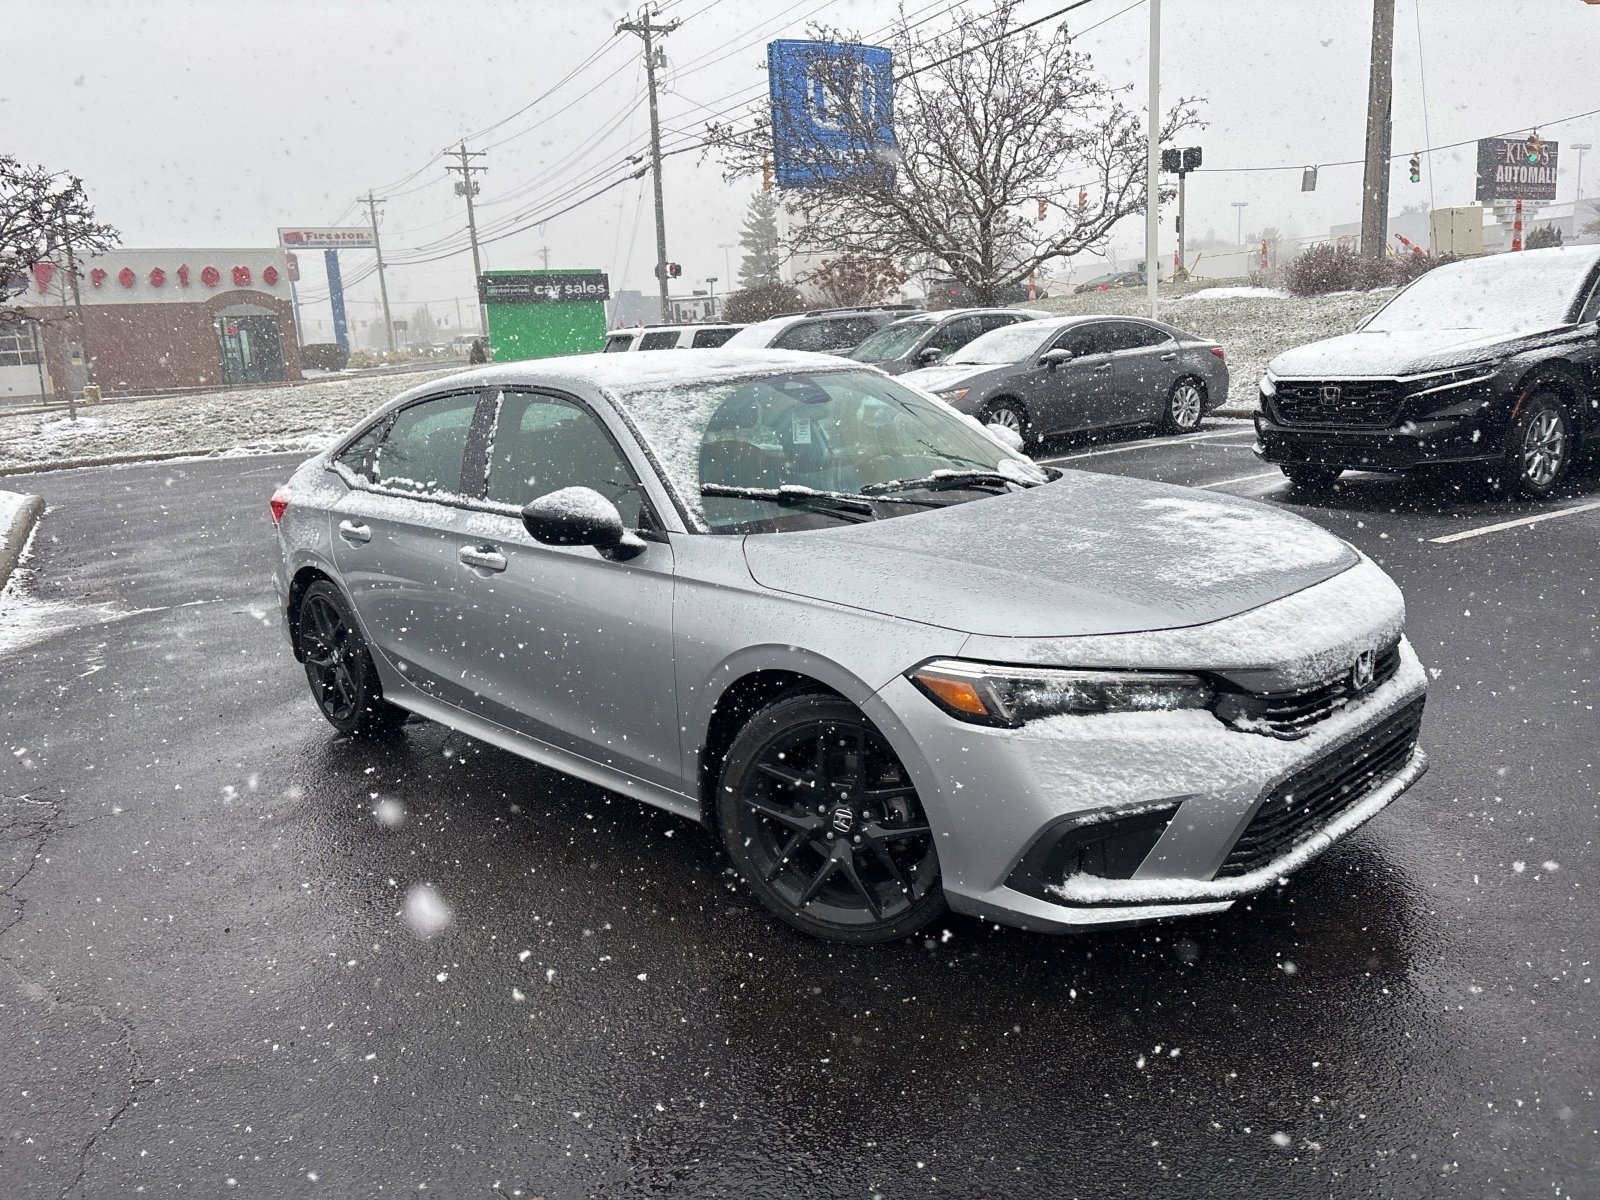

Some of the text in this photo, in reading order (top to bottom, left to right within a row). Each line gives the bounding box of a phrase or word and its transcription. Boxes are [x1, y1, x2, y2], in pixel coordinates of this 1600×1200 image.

[1505, 142, 1549, 165] KINS
[1496, 165, 1557, 184] AUTOMALL
[534, 284, 562, 295] car
[564, 281, 606, 294] sales
